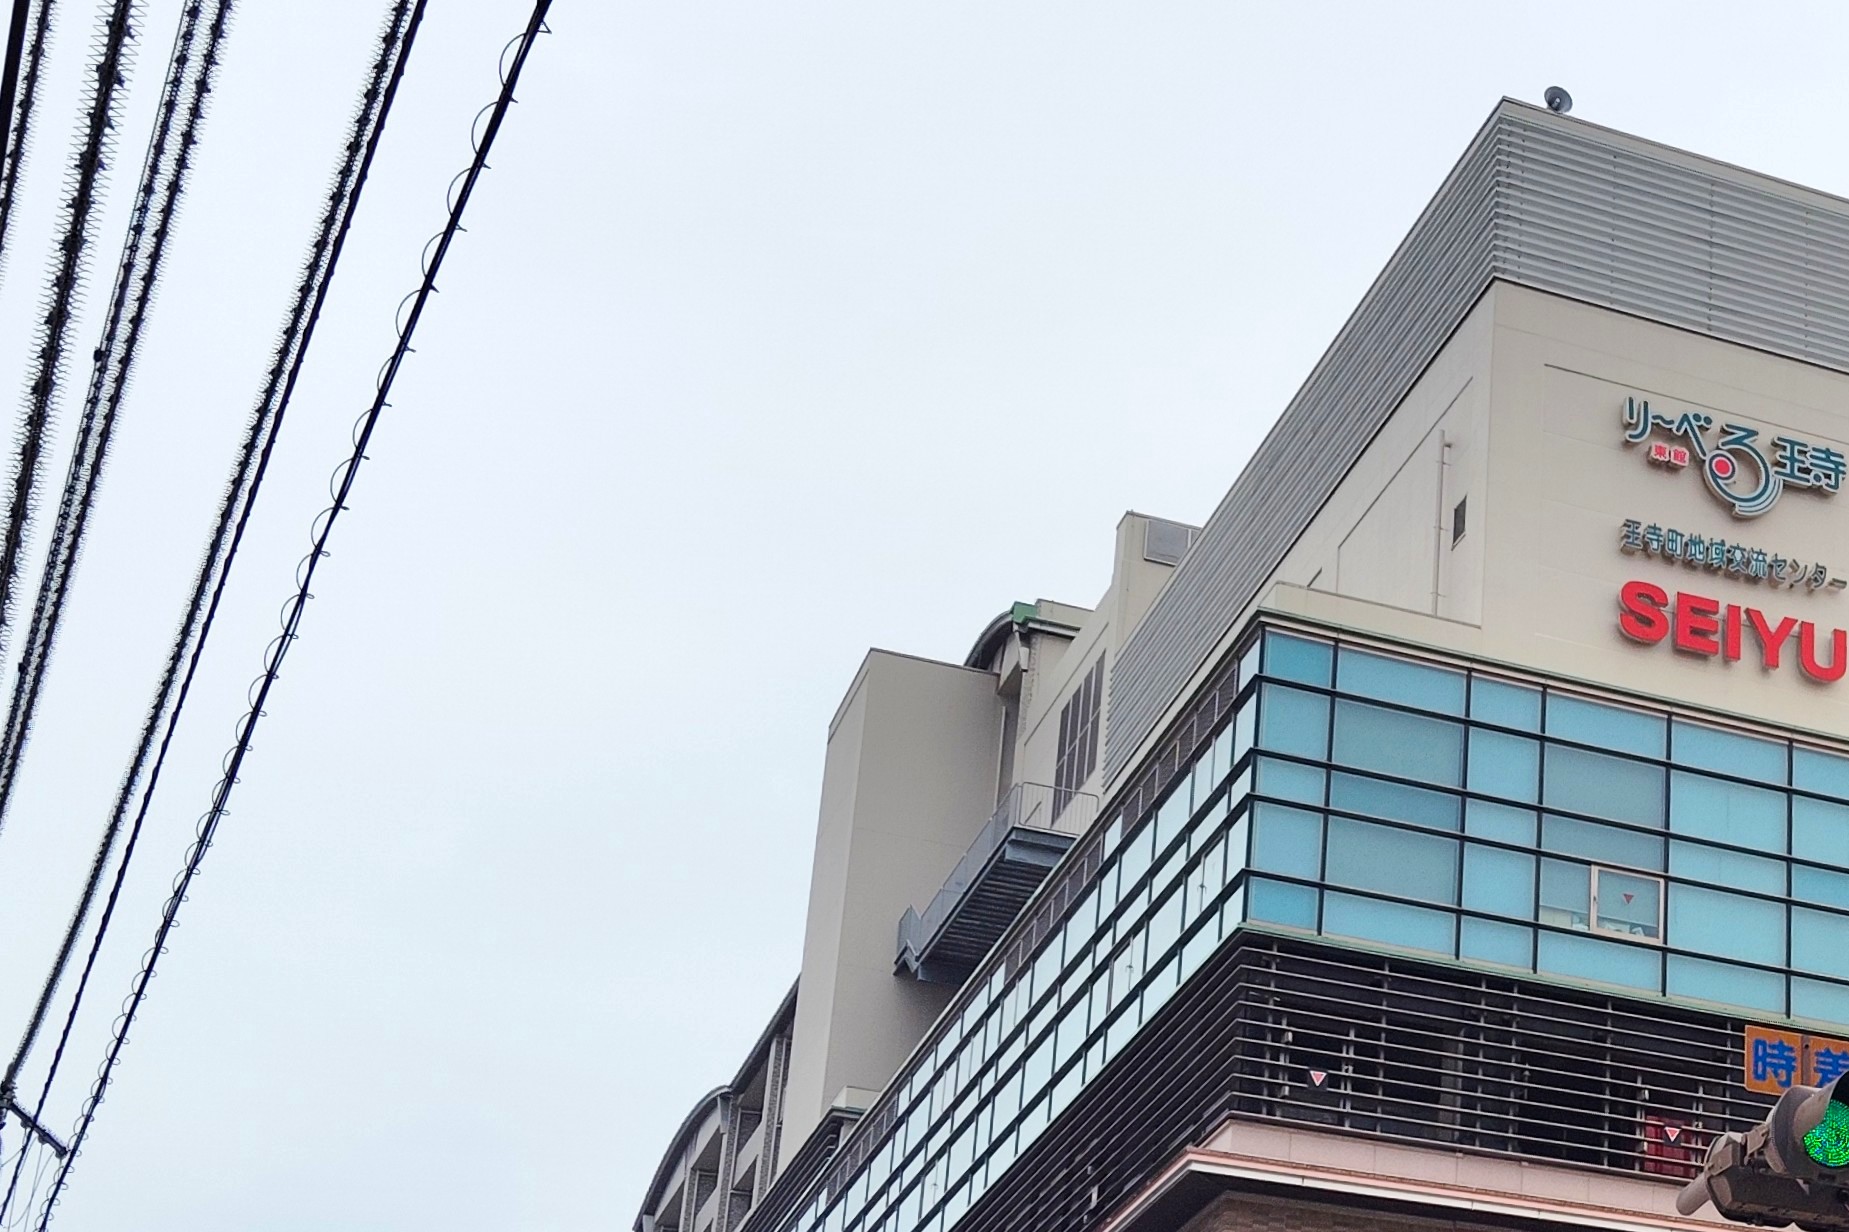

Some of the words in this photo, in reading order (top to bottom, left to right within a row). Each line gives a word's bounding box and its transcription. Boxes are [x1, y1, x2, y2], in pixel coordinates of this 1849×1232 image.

[1622, 518, 1848, 590] 王寺町地域交流センター
[1619, 580, 1848, 682] SEIYU
